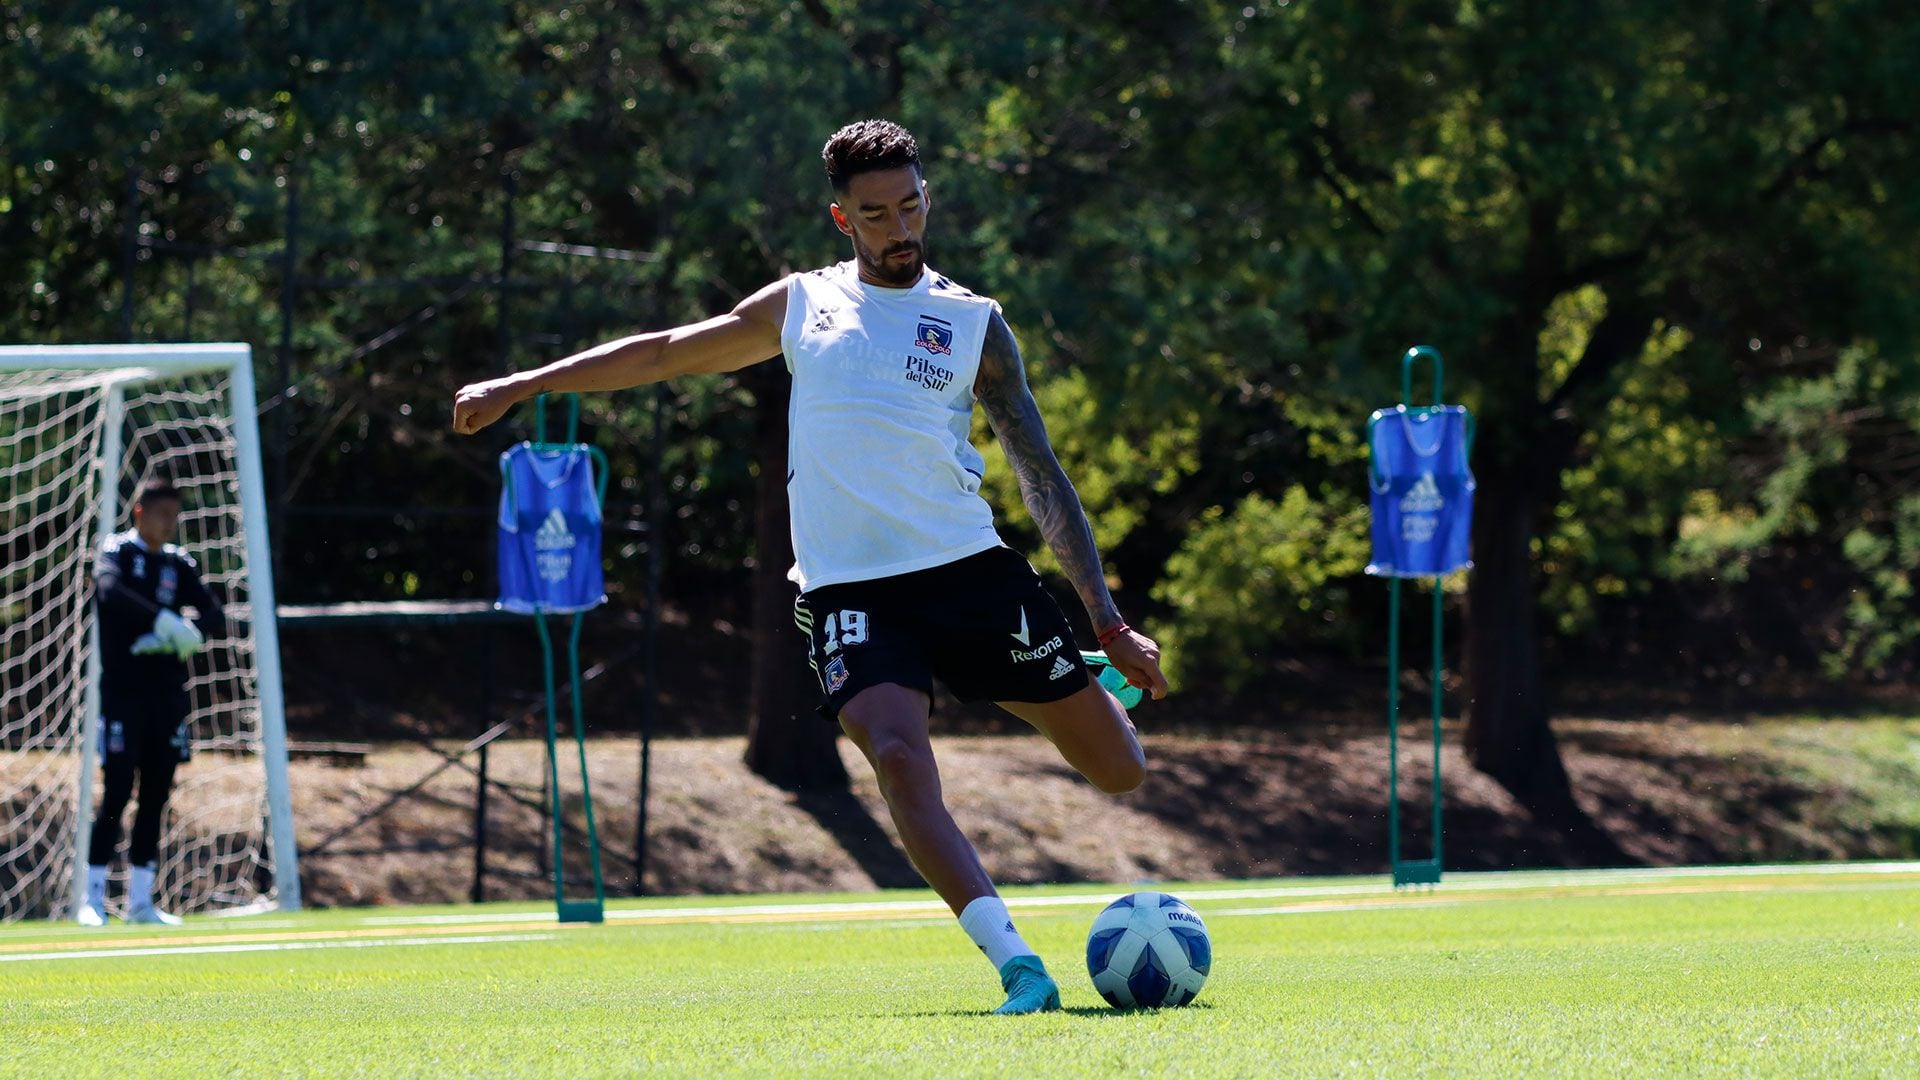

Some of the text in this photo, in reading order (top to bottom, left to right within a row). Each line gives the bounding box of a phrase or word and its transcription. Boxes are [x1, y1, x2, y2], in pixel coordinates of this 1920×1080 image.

[915, 340, 951, 356] COLO-COLO
[906, 355, 954, 382] Pilsen
[906, 370, 948, 392] del Sur
[824, 609, 869, 656] 19
[1010, 636, 1063, 663] Rexona
[1049, 663, 1076, 681] adidas
